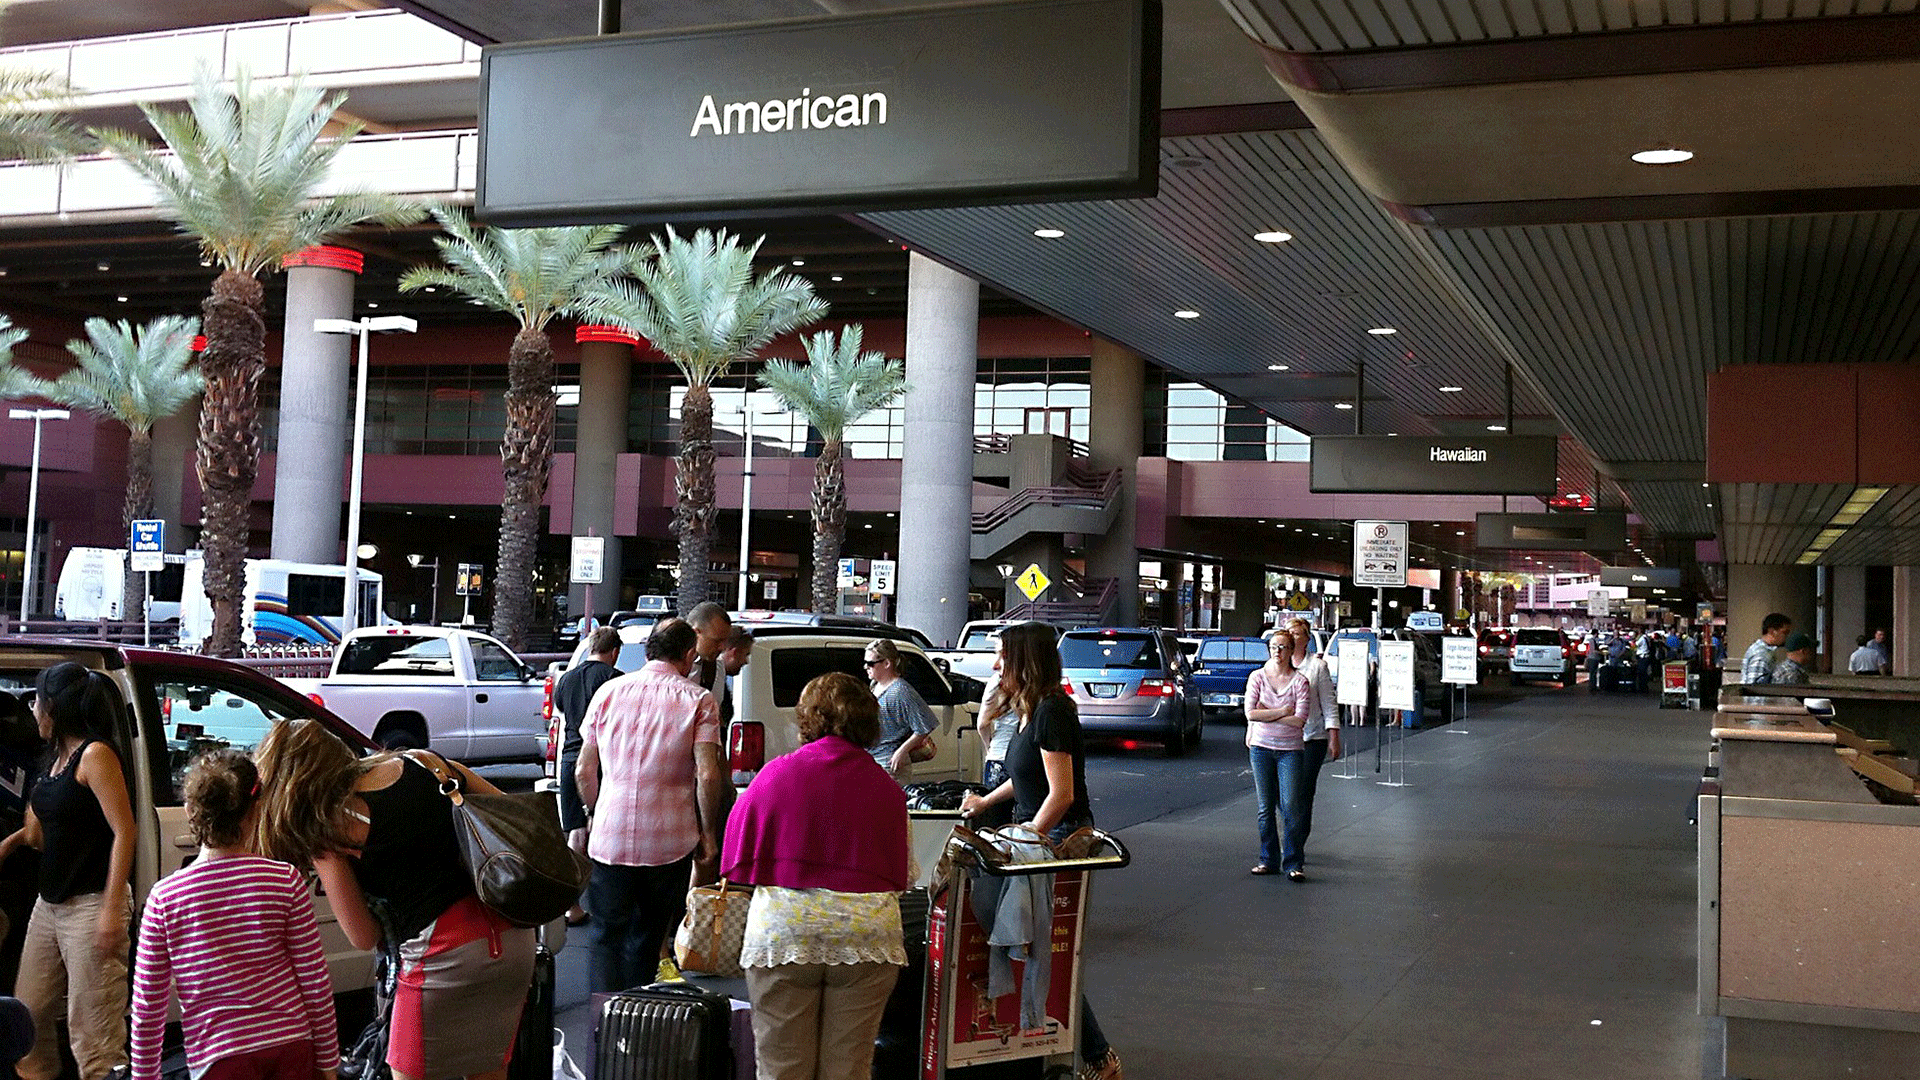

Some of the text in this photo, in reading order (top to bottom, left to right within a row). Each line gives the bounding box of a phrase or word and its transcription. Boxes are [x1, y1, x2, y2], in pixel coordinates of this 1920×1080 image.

[689, 87, 888, 138] American
[1429, 445, 1487, 462] Hawaiian
[136, 522, 159, 533] Rental
[140, 532, 154, 542] Car
[135, 541, 159, 551] Shuttle
[877, 577, 887, 590] 5
[1053, 895, 1071, 908] ing.
[1053, 926, 1069, 936] this
[1051, 942, 1069, 953] BLE!
